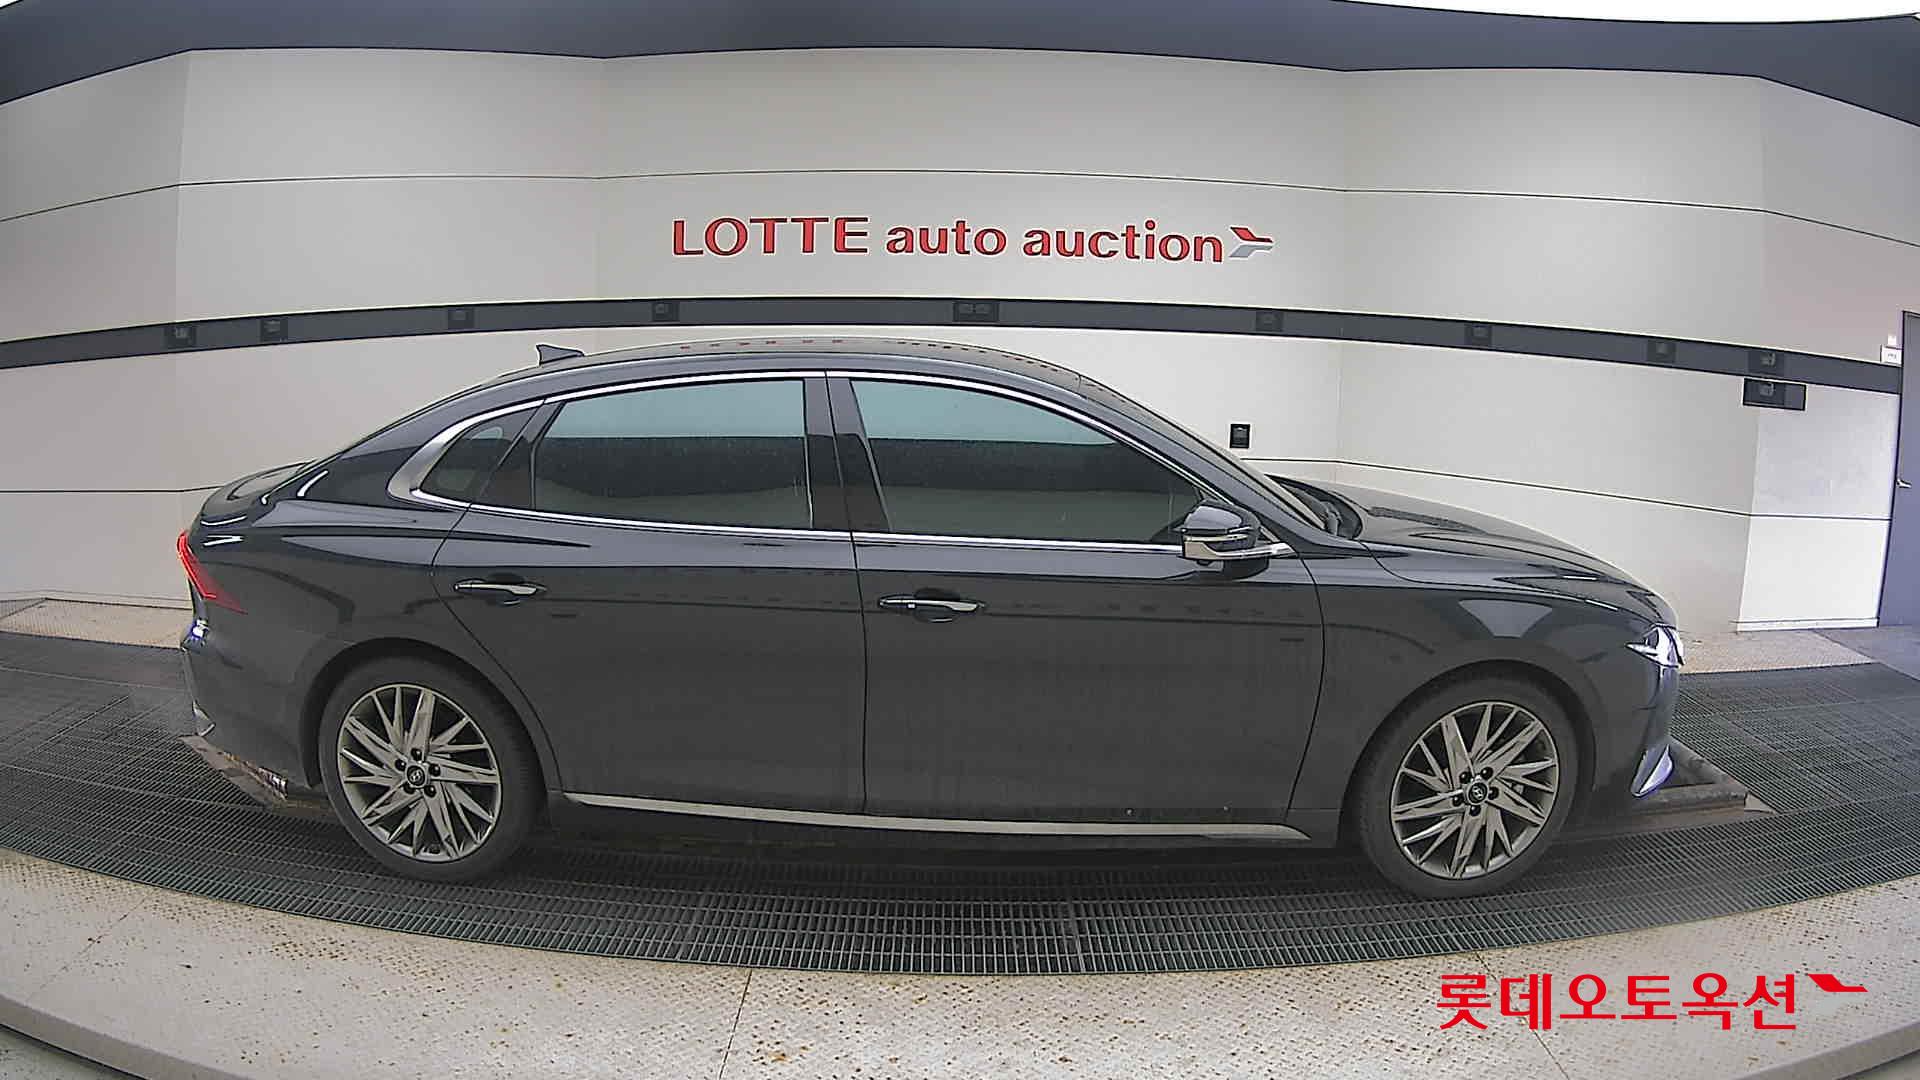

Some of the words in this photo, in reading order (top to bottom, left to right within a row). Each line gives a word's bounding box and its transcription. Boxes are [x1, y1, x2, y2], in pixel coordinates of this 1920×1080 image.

[673, 217, 869, 256] LOTTE
[886, 220, 1008, 256] auto
[1022, 219, 1224, 262] auction
